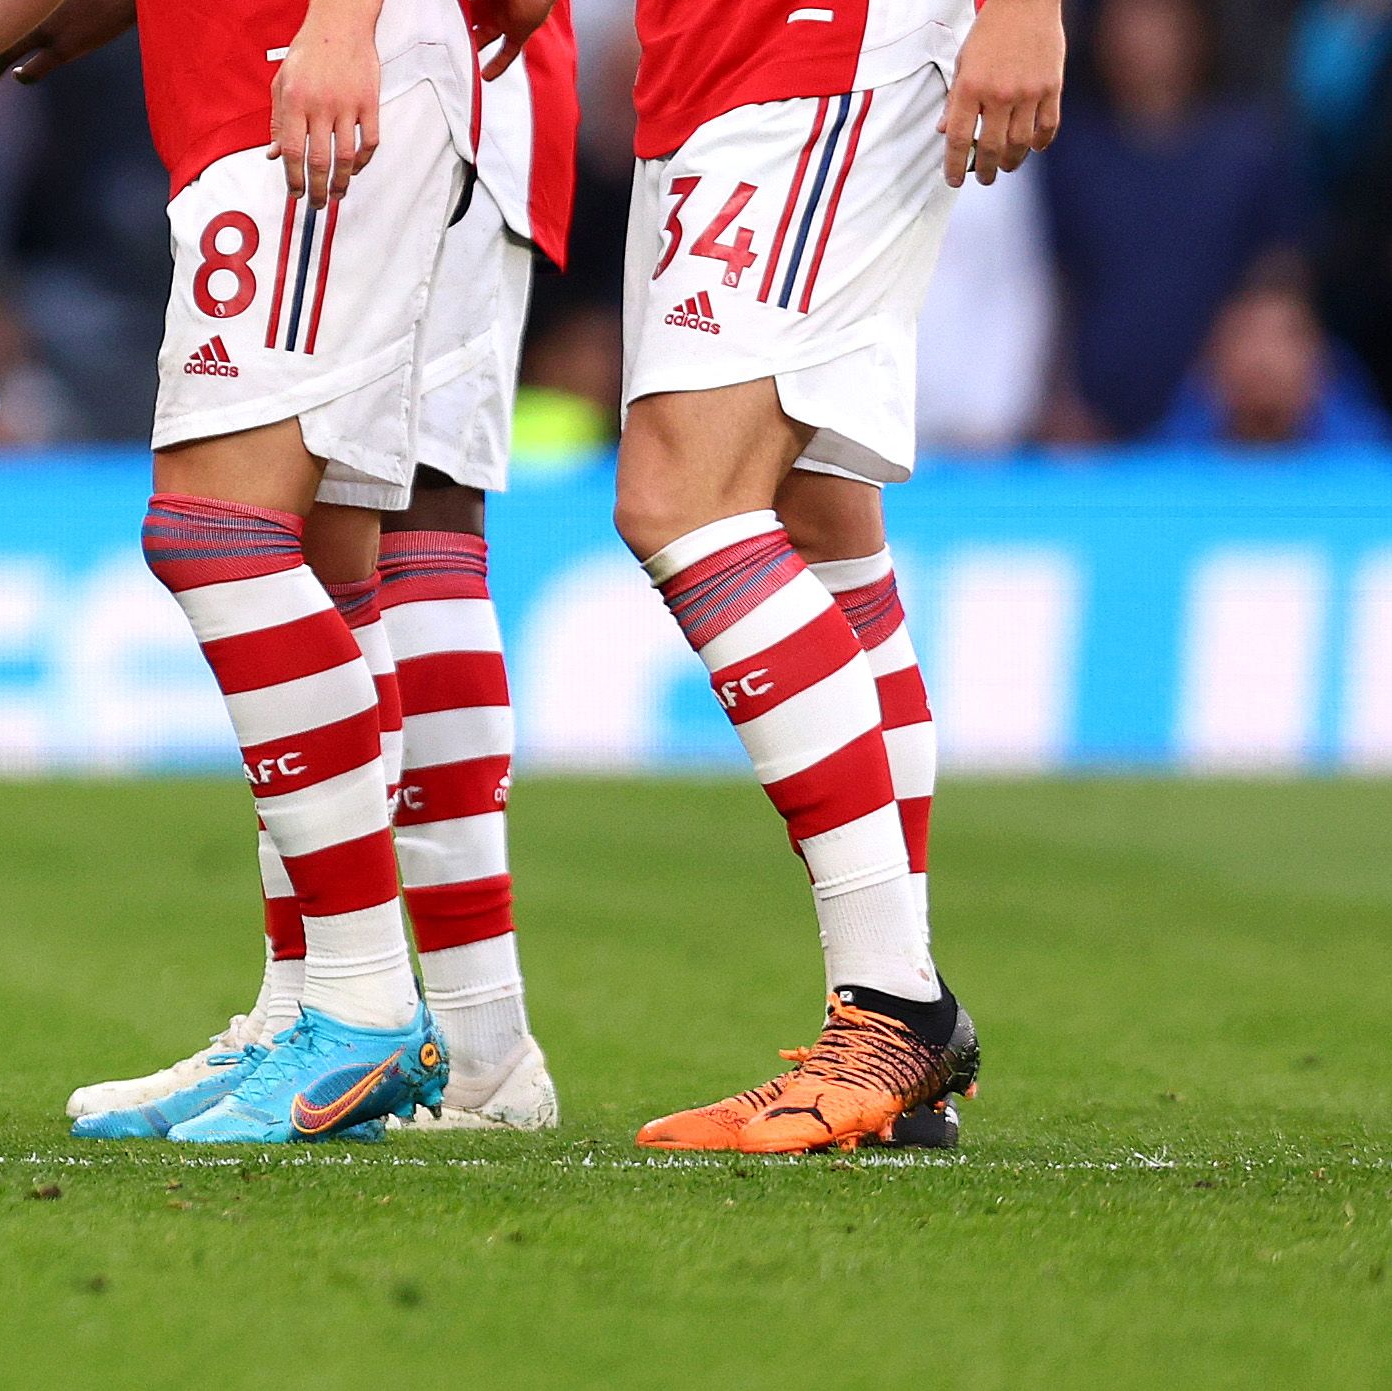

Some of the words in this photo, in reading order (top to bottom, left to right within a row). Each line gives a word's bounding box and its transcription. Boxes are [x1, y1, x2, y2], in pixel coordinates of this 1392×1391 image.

[192, 210, 260, 318] 8
[651, 175, 759, 289] 34
[664, 312, 721, 335] adidas
[183, 361, 239, 378] adidas
